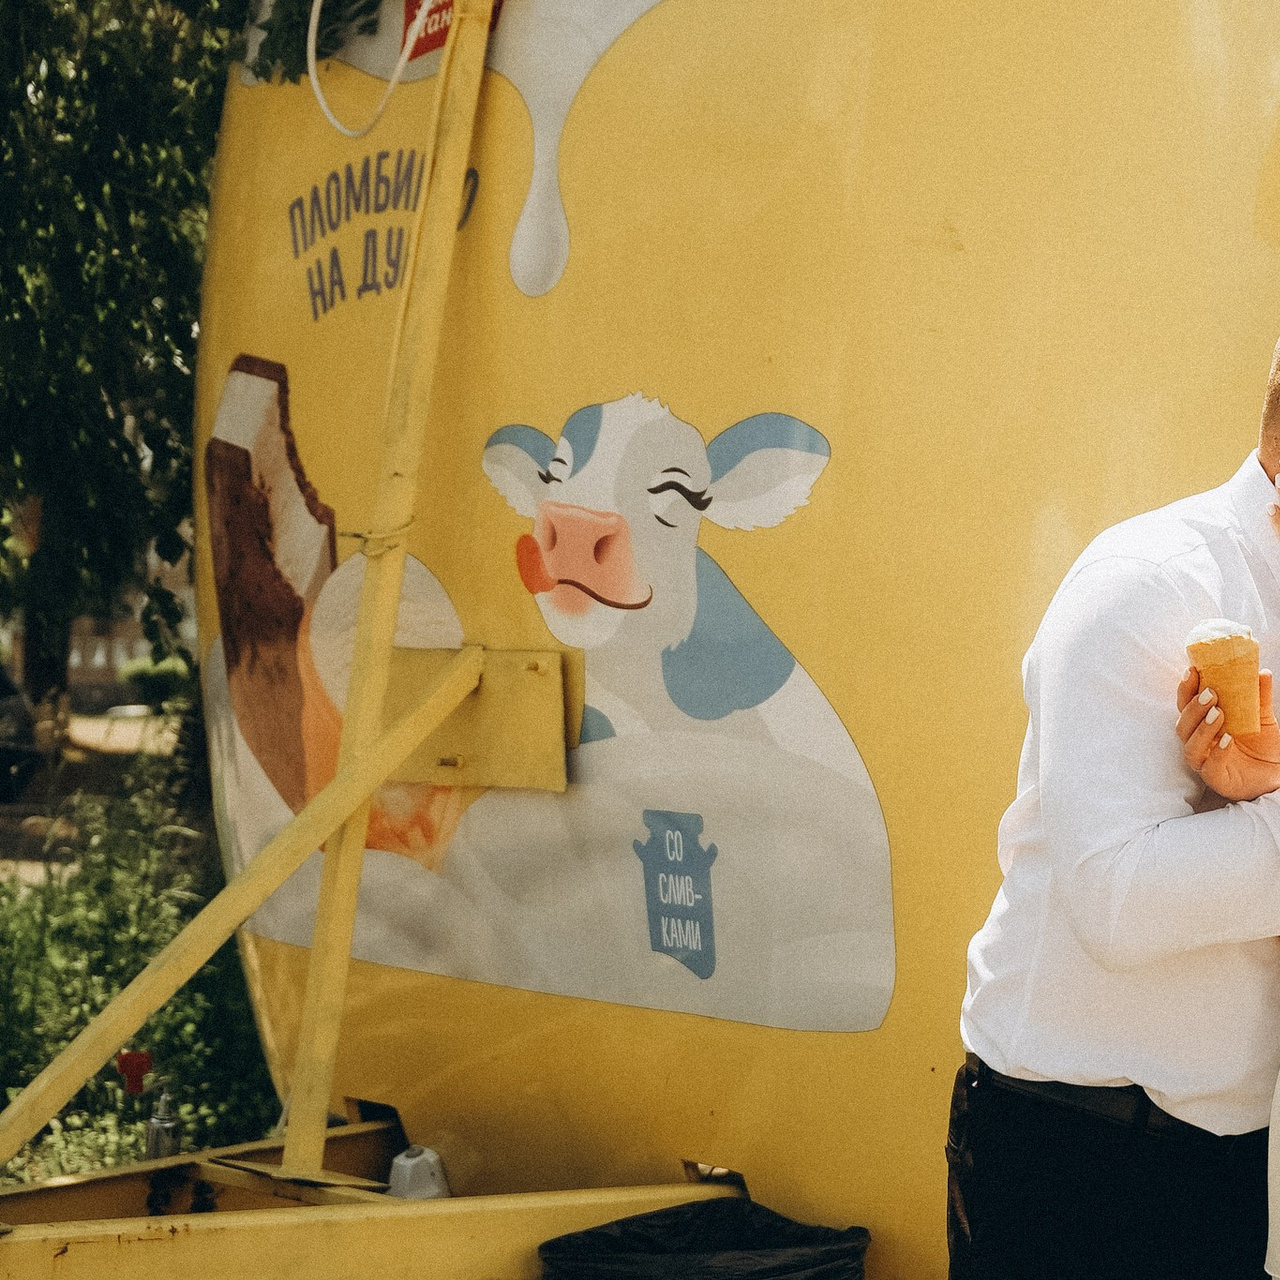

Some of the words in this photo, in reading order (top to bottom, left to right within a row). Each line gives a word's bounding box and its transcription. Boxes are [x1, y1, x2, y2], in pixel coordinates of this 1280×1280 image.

[306, 246, 346, 322] НА
[665, 829, 683, 862] СО
[658, 873, 702, 907] СЛИВ-
[660, 916, 702, 951] КАМИ
